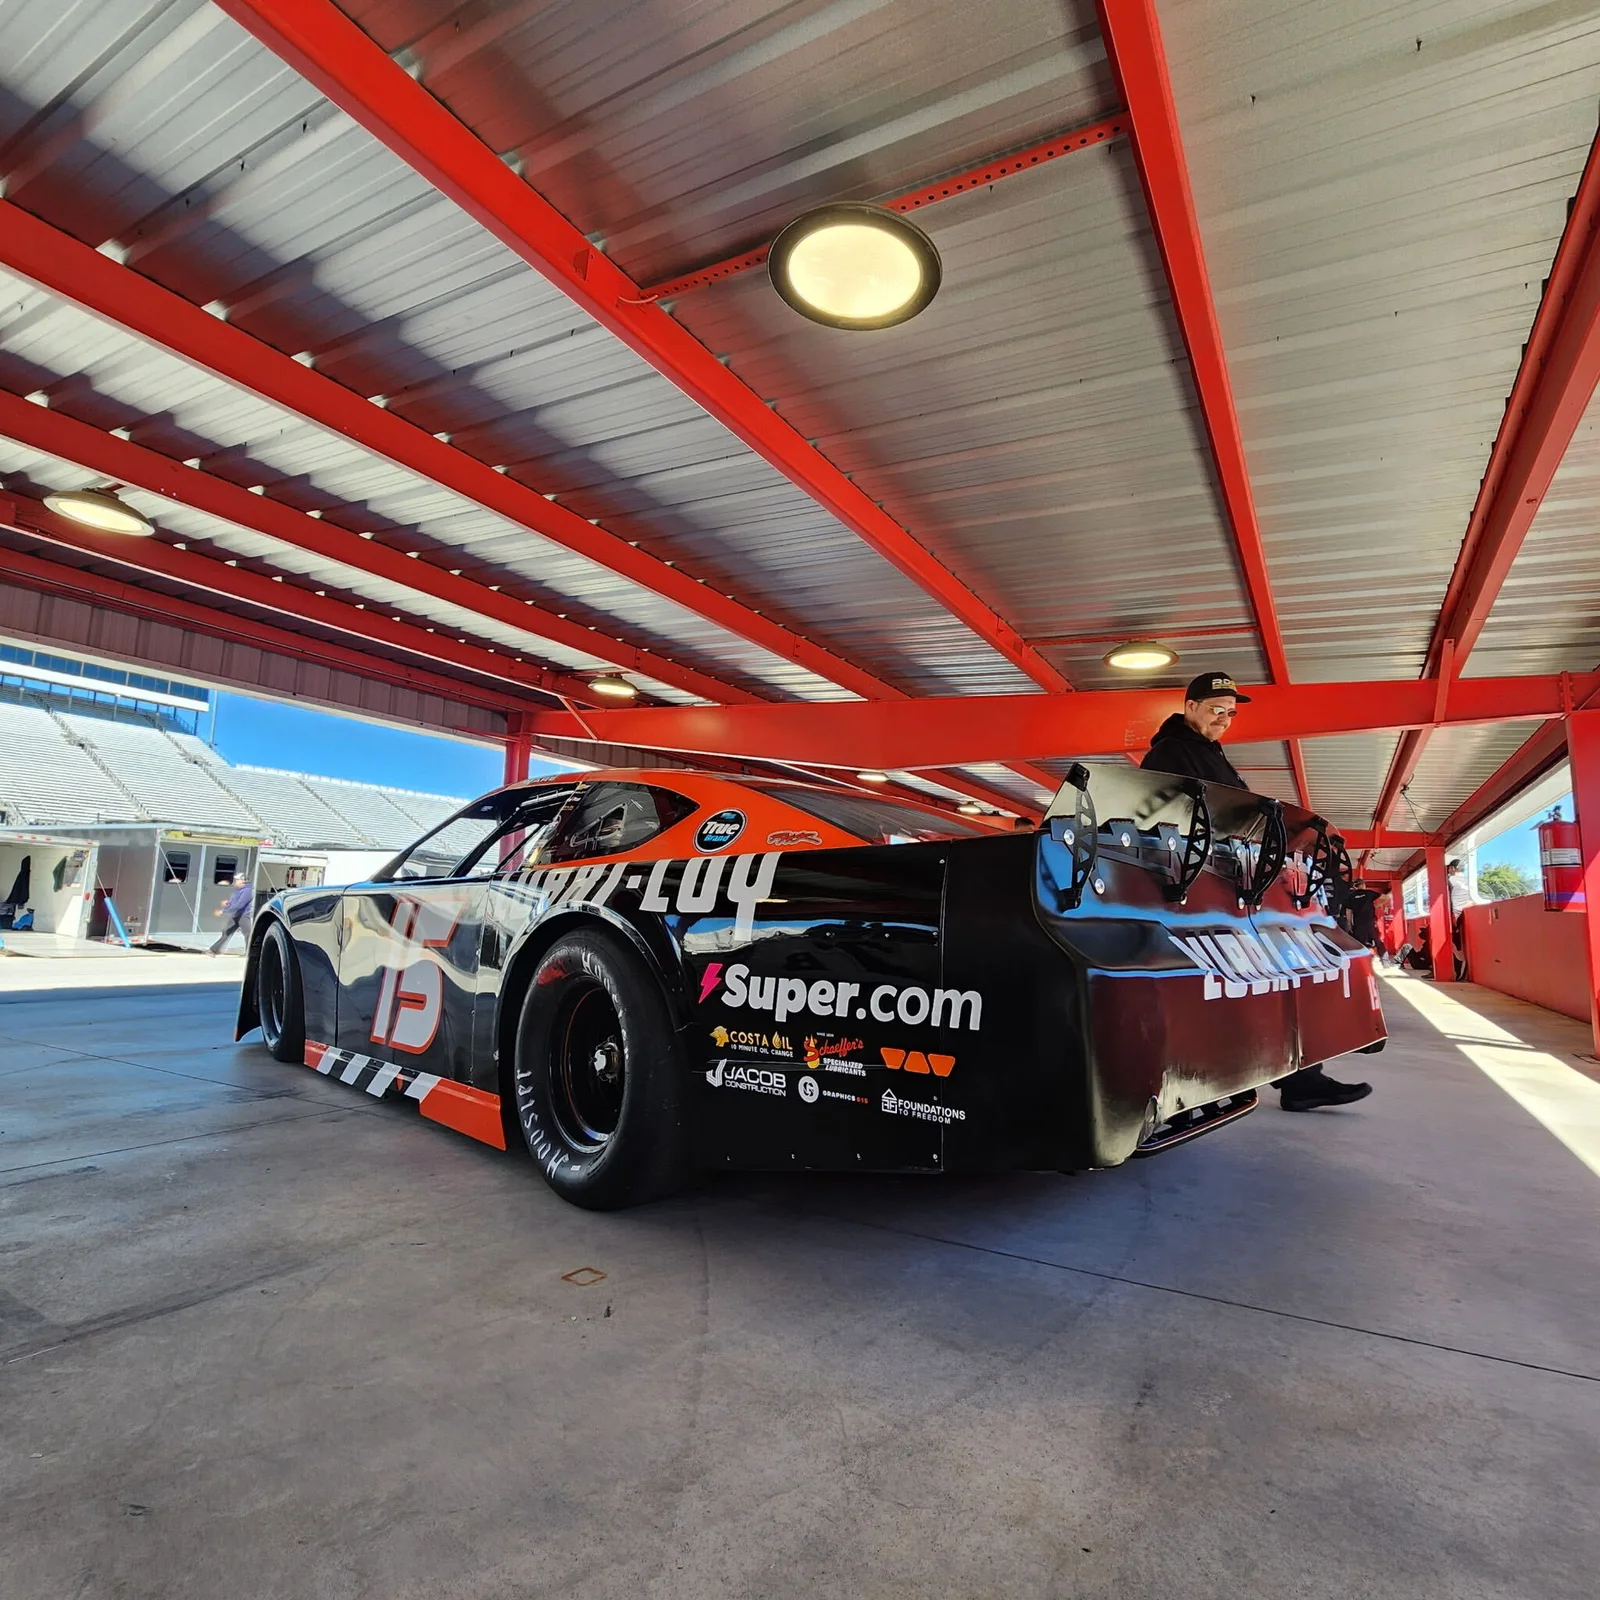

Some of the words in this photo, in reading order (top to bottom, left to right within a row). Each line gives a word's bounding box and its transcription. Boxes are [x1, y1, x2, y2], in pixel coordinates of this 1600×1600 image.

[702, 821, 740, 835] True
[703, 834, 731, 842] Brand
[370, 895, 469, 1054] 15
[721, 963, 983, 1031] Super.com
[729, 1030, 769, 1047] COSTA
[772, 1031, 793, 1050] OIL
[738, 1044, 758, 1053] MINUTE
[770, 1049, 793, 1058] CHANGE
[803, 1037, 864, 1062] Schaeffer's
[822, 1057, 864, 1069] SPECIALIZED
[825, 1064, 866, 1077] LUBRICANTS
[724, 1066, 786, 1088] JACOB
[724, 1079, 786, 1097] CONSTRUCTION
[822, 1090, 856, 1101] GRAPHICS
[898, 1099, 966, 1120] FOUNDATIONS
[898, 1108, 909, 1116] TO
[911, 1110, 951, 1124] FREEDOM
